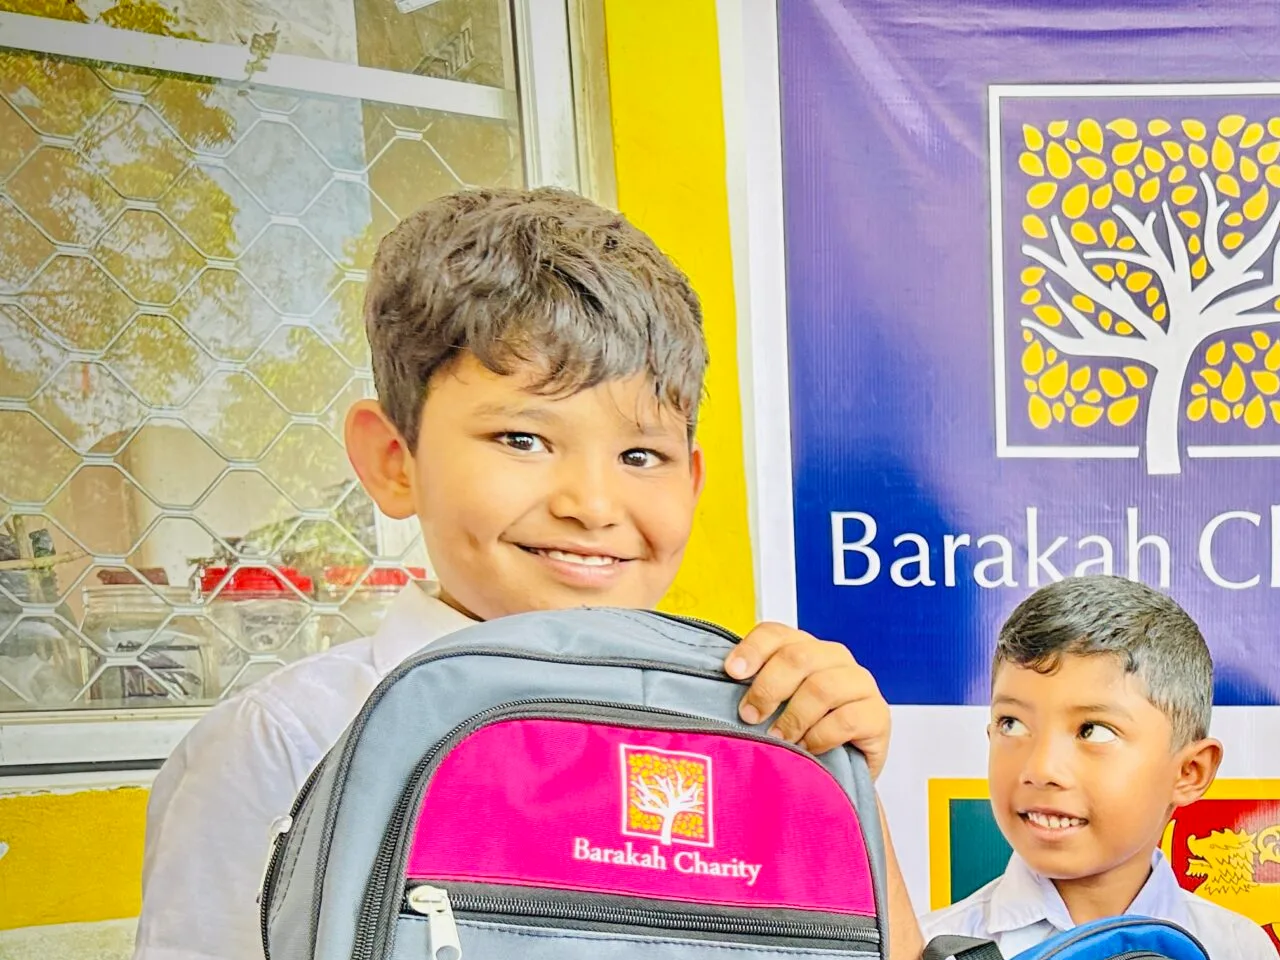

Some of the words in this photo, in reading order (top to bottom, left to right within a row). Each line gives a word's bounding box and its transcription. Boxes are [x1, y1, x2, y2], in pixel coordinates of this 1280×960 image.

[831, 506, 1171, 588] Barakah
[573, 837, 667, 871] Barakah
[674, 852, 762, 885] Charity
